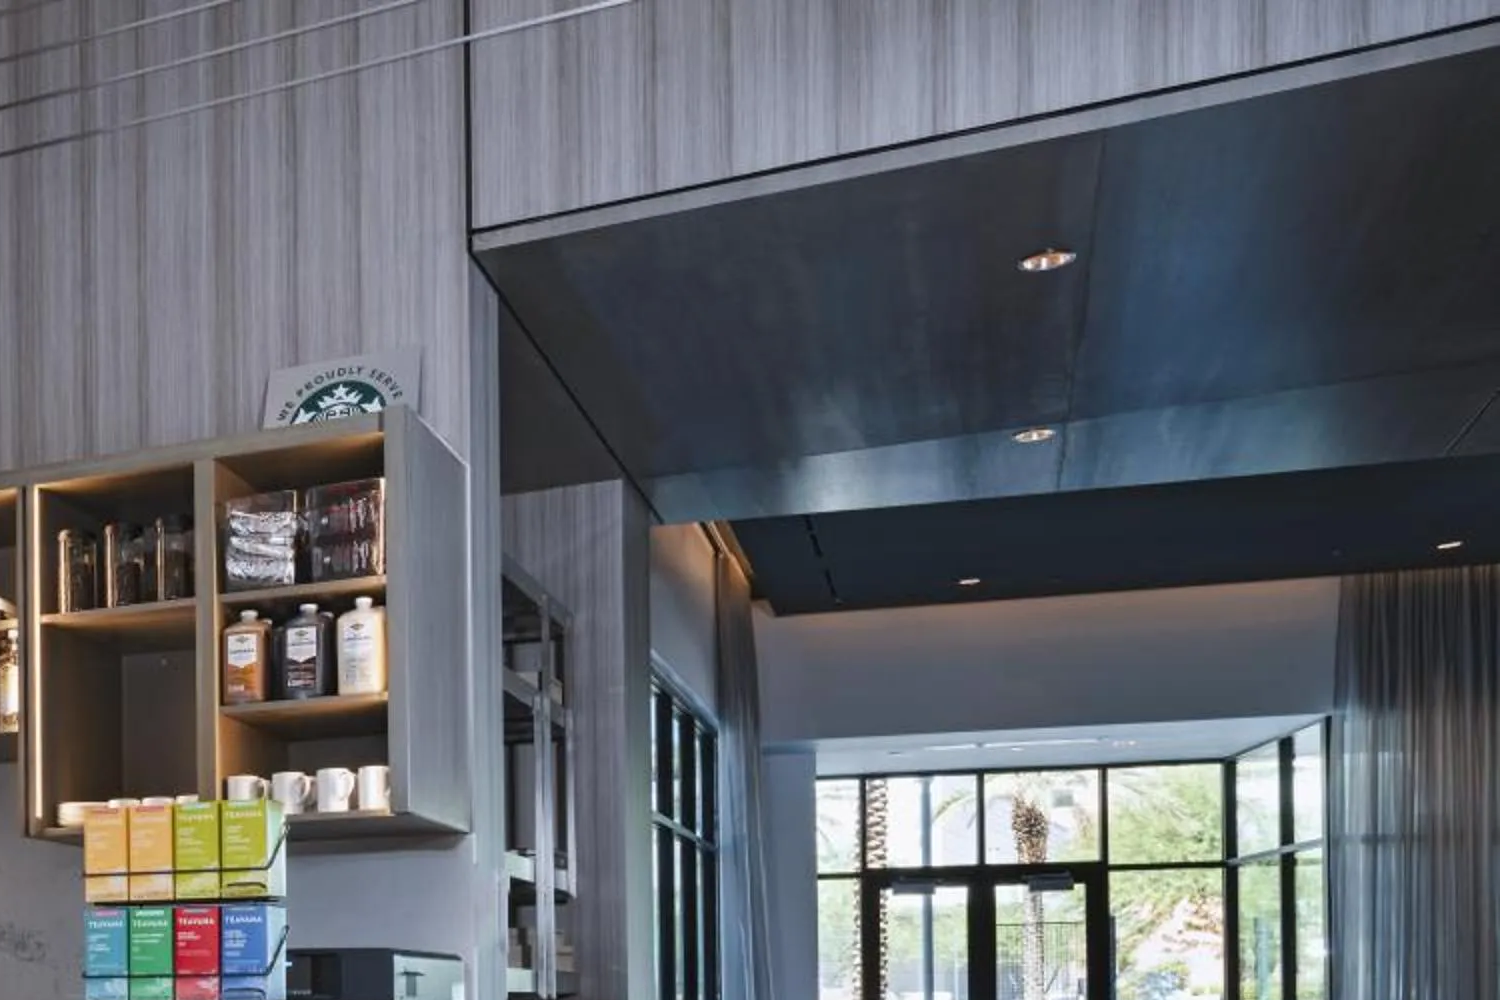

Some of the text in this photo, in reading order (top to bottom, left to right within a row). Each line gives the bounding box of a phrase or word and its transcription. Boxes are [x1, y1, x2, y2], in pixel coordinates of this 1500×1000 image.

[276, 365, 404, 422] WE PROUDLY SERVE
